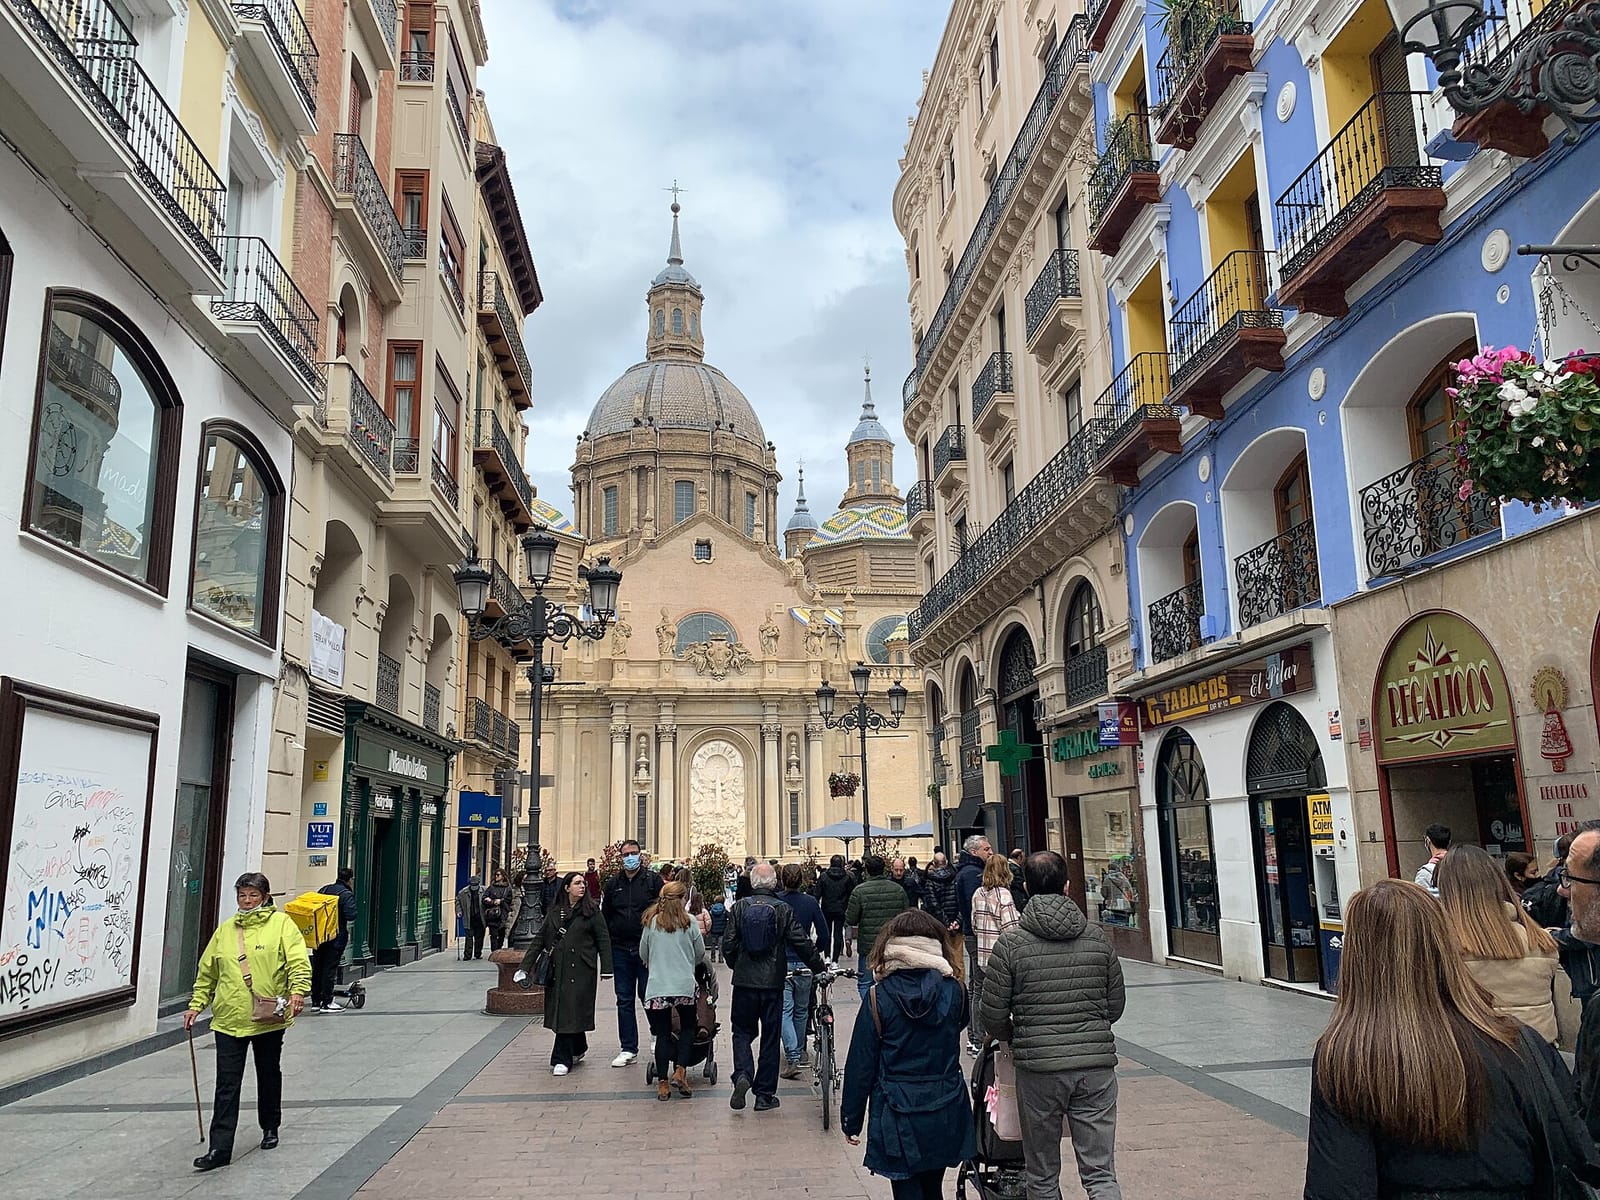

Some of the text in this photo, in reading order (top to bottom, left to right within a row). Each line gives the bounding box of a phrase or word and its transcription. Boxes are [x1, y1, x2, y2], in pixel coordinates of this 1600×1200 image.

[1163, 675, 1228, 712] TABACOS
[1250, 660, 1299, 698] El Pilar
[1387, 658, 1494, 728] REGALICOS
[1052, 727, 1118, 763] FARMAC
[1312, 800, 1332, 815] ATM
[1558, 803, 1574, 818] DEL
[310, 824, 332, 833] VUT
